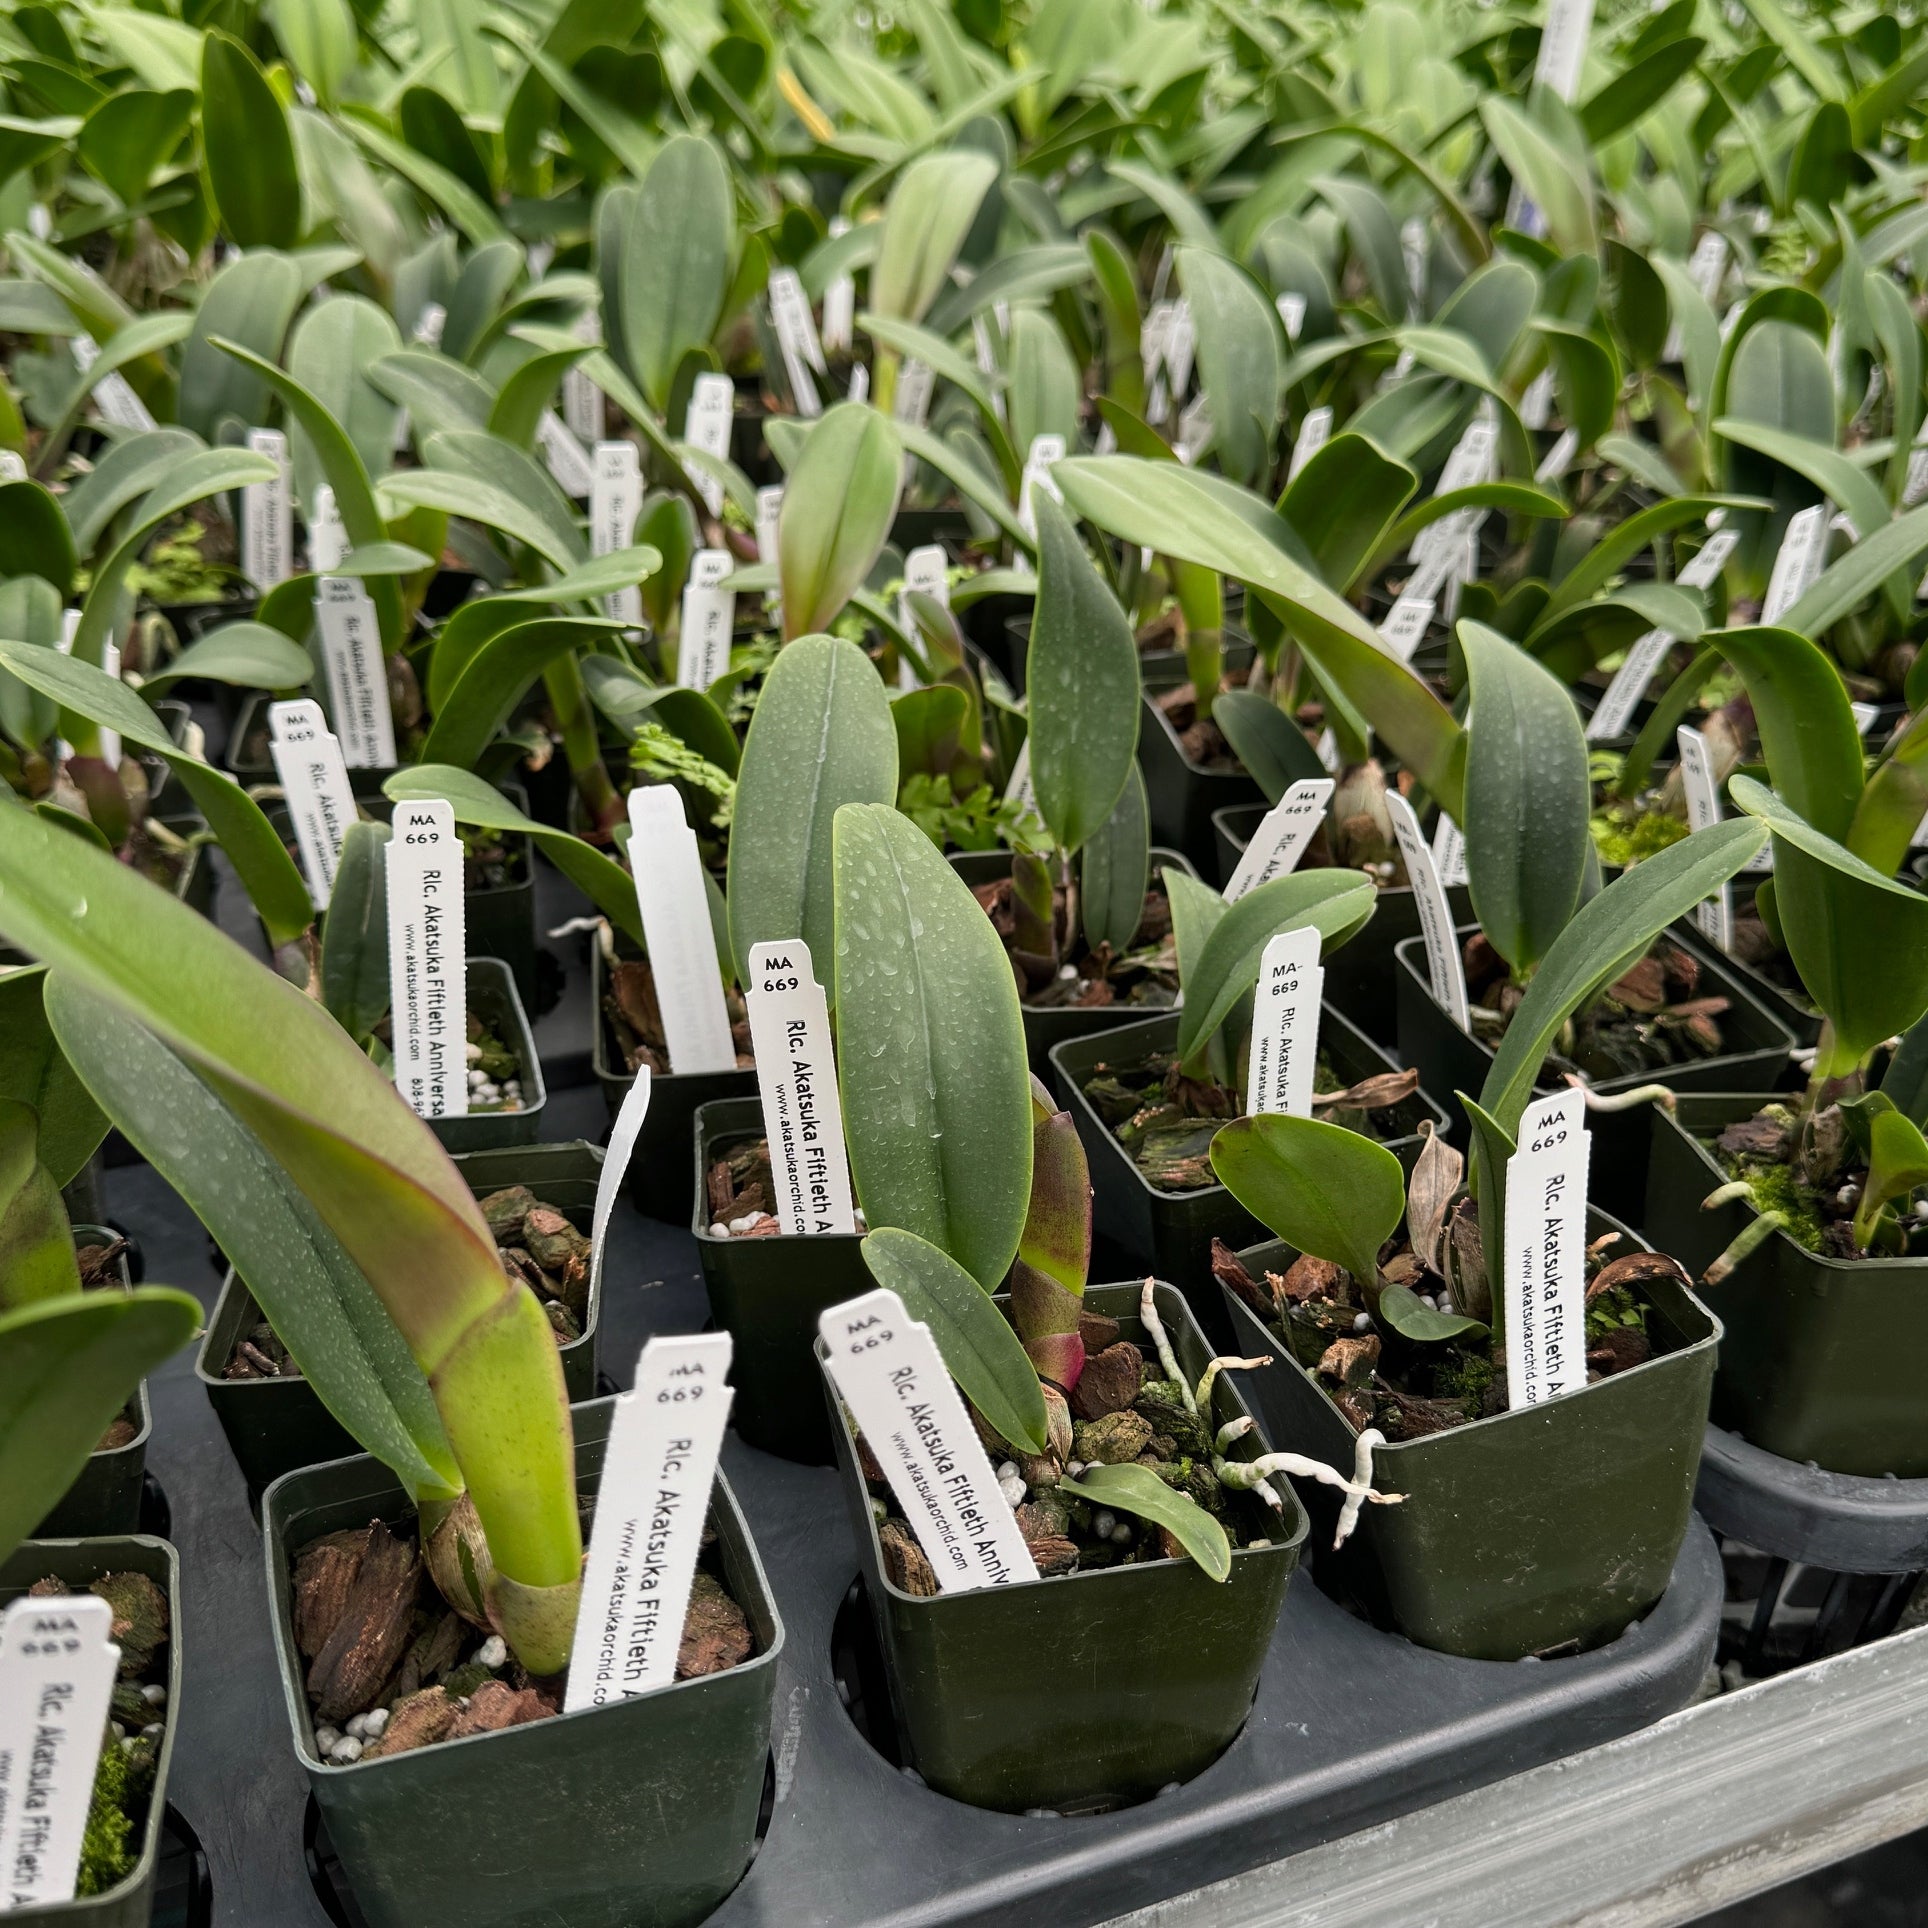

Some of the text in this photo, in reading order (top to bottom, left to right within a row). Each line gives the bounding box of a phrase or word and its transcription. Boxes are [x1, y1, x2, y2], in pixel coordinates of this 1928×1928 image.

[1285, 806, 1312, 815] 669
[1296, 792, 1316, 801] MA
[410, 815, 436, 826] MA
[405, 833, 439, 844] 669
[423, 870, 442, 898] Rlc.
[424, 904, 445, 974] Akatsuka
[765, 956, 793, 970] MA
[404, 923, 421, 1061] www.akatsukaorchid.com
[764, 977, 798, 992] 669
[1272, 980, 1298, 996] 669
[427, 979, 447, 1036] Fiftieth
[1281, 1007, 1296, 1035] Rlc.
[786, 1020, 807, 1053] Rlc.
[1276, 1038, 1293, 1099] Akatsuka
[792, 1060, 820, 1142] Akatsuka
[1538, 1110, 1566, 1131] MA
[1531, 1130, 1567, 1152] 669
[775, 1083, 806, 1235] www.akatsukaorchid.co
[805, 1147, 832, 1213] Fiftieth
[1544, 1173, 1565, 1211] Rlc.
[1543, 1217, 1564, 1302] Akatsuka
[847, 1314, 883, 1335] MA
[850, 1330, 893, 1354] 669
[1544, 1304, 1565, 1376] Fiftieth
[669, 1362, 705, 1377] MA
[656, 1385, 704, 1403] 669
[660, 1437, 692, 1480] Rlc.
[889, 1366, 918, 1401] Rlc.
[906, 1402, 955, 1476] Akatsuka
[944, 1474, 989, 1538] Fiftieth
[891, 1431, 968, 1571] www.akatsukaorchid.com
[639, 1488, 681, 1591] Akatsuka
[623, 1598, 661, 1681] Fiftieth
[25, 1724, 67, 1810] Akatsuka
